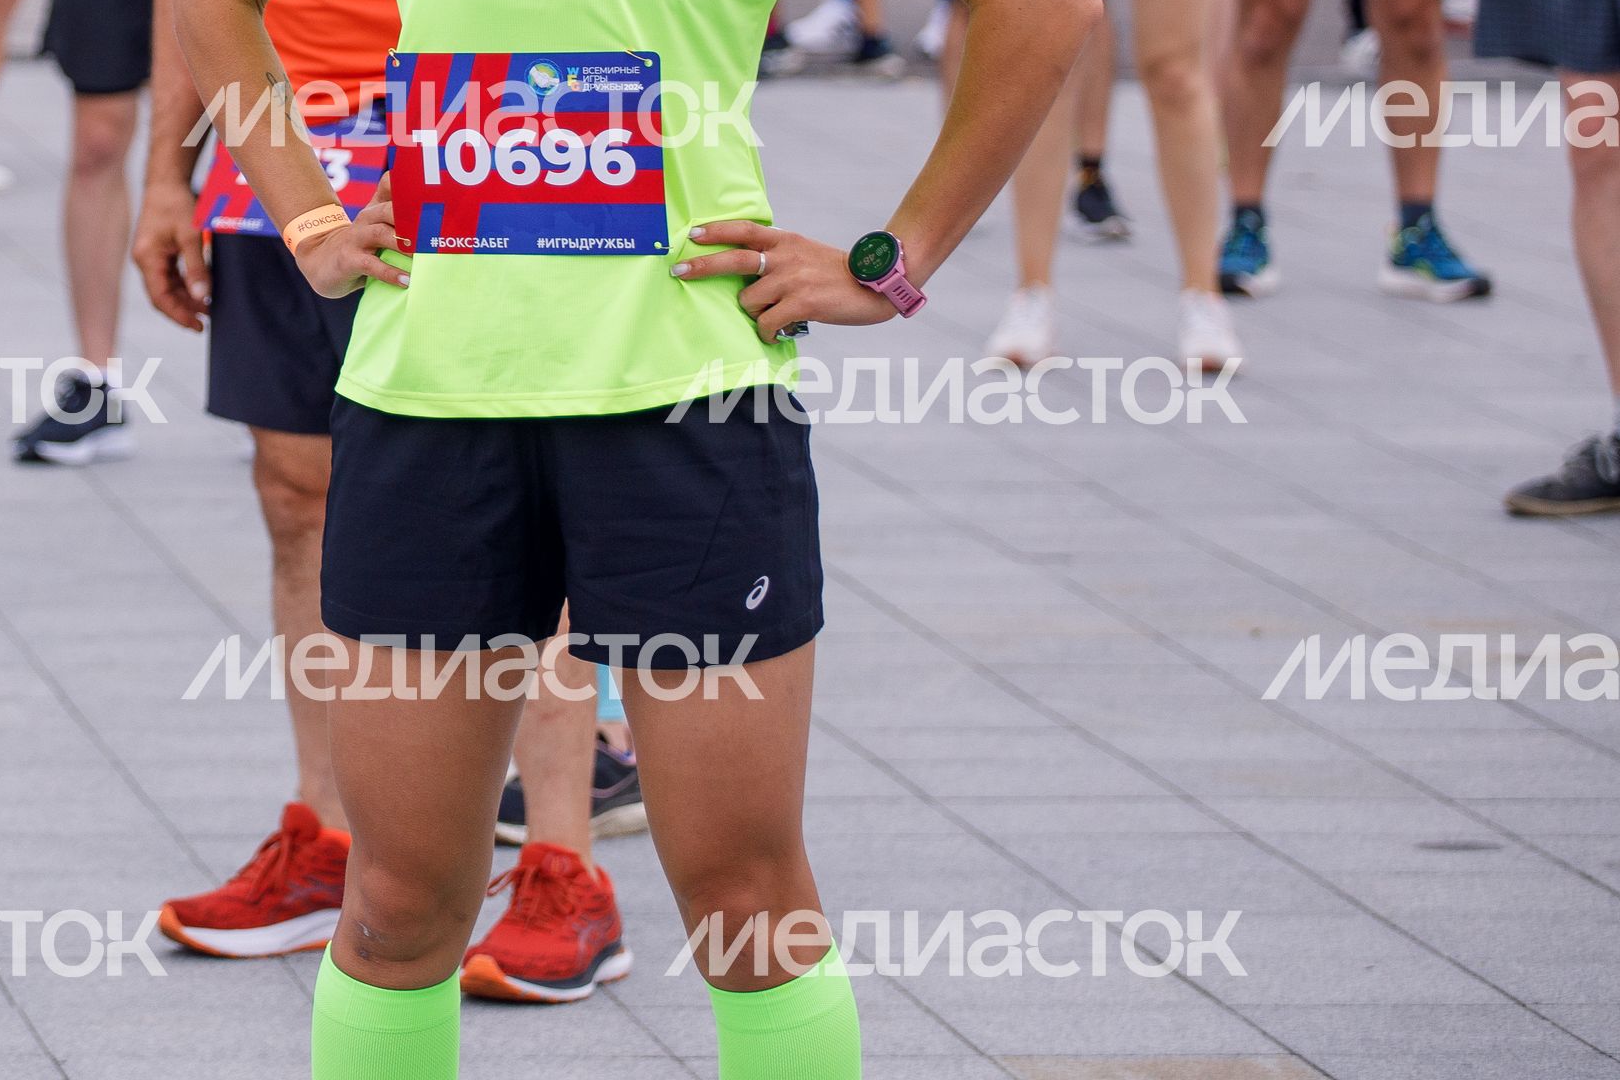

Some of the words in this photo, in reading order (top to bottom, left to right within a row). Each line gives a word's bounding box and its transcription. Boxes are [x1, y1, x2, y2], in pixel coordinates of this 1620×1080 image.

[582, 66, 640, 75] ВСЕМИРНЫЕ
[582, 75, 608, 83] ИГРЫ
[412, 128, 636, 187] 10696
[430, 237, 510, 249] #БОКСЗАБЕГ
[536, 237, 636, 251] #ИГРЫДРУЖБЫ
